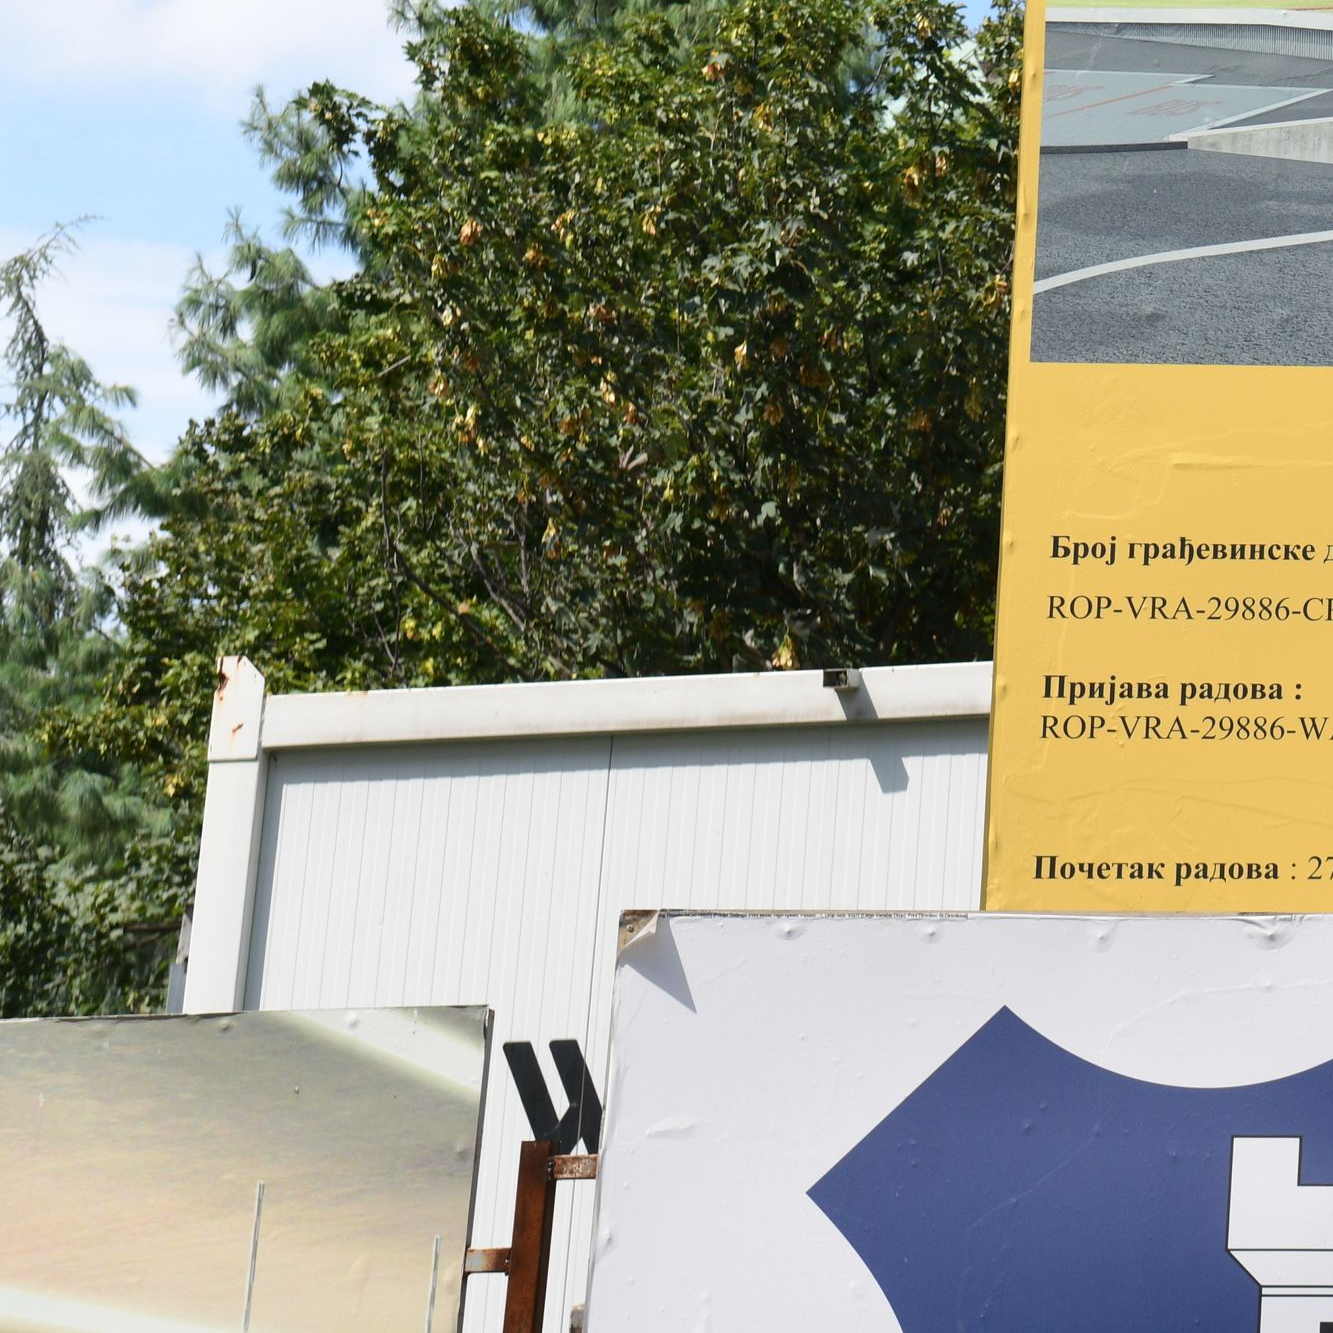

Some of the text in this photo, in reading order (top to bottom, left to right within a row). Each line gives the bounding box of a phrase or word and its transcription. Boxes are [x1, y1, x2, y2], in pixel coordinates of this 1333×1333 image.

[1049, 535, 1117, 567] Број
[1127, 537, 1316, 567] грађевинске
[1041, 675, 1170, 707] Пријава
[1178, 683, 1284, 707] радова
[1032, 855, 1166, 881] Почетак
[1173, 862, 1280, 888] радова
